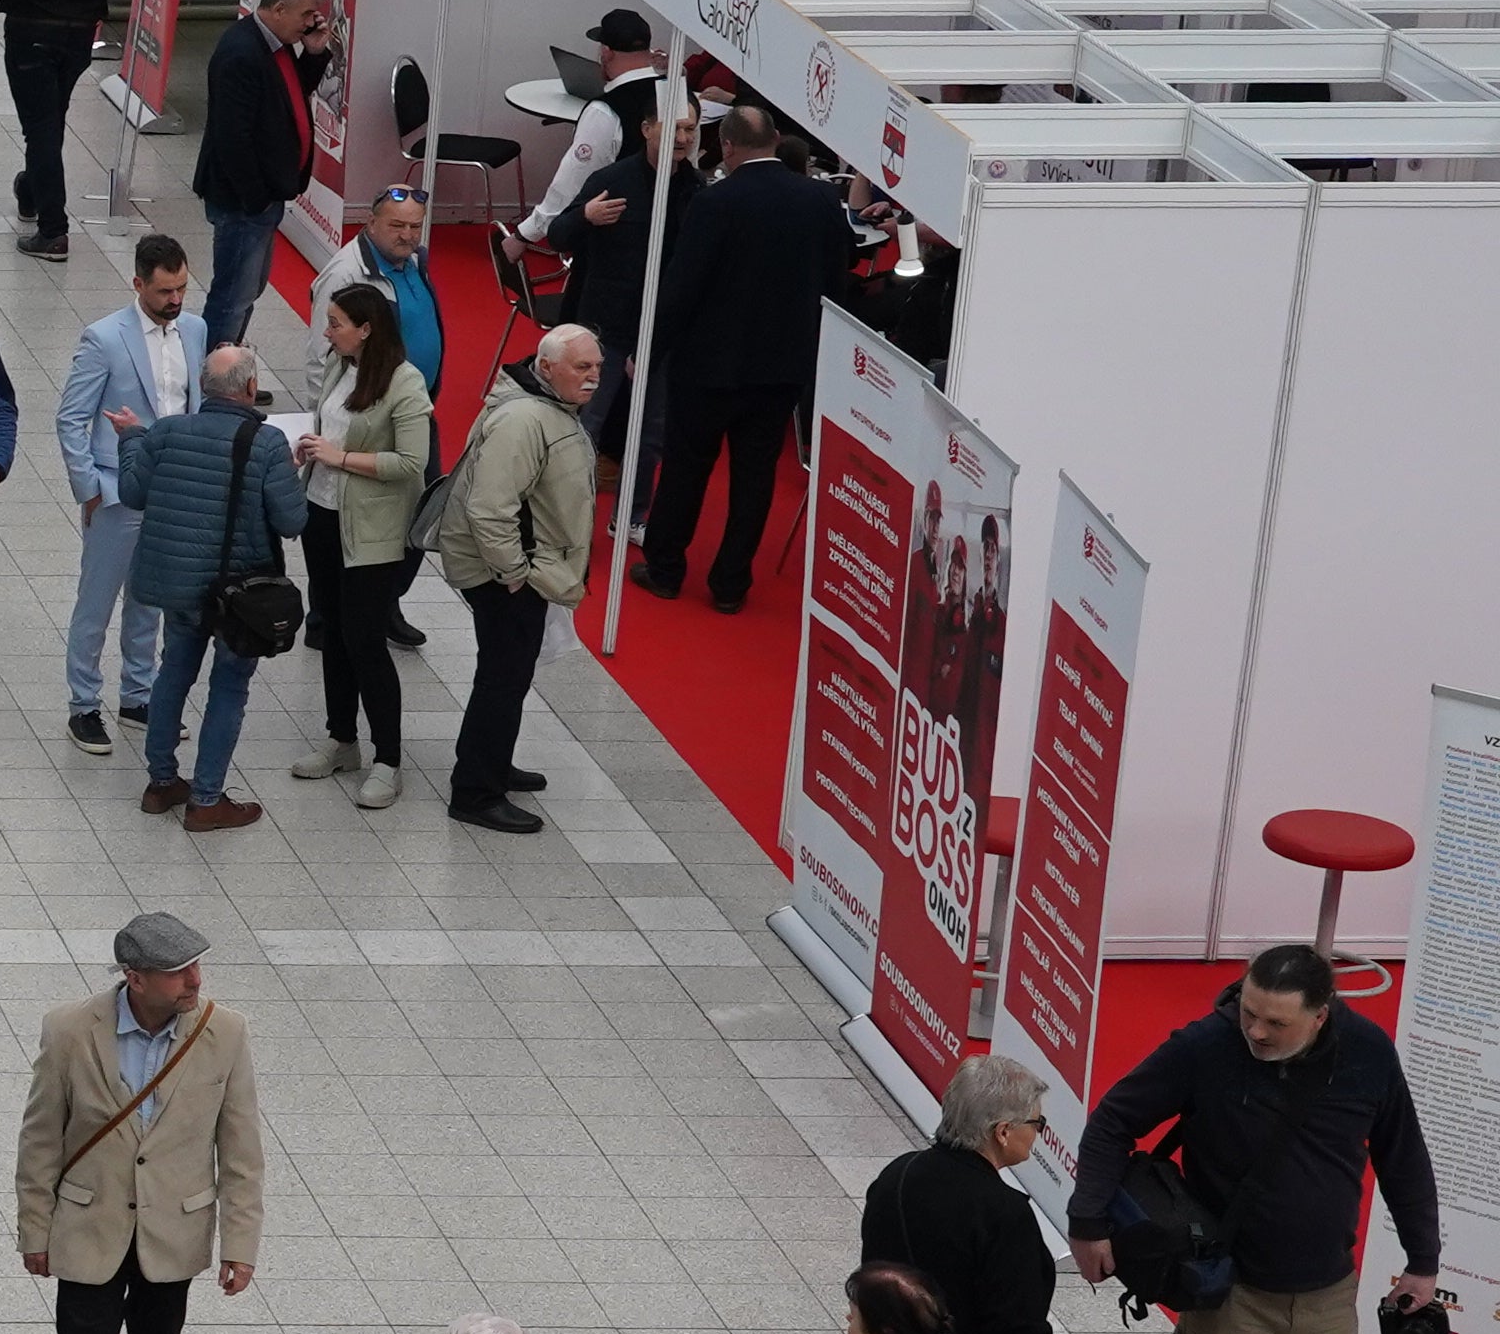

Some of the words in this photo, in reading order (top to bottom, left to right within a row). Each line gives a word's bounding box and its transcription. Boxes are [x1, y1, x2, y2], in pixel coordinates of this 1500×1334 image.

[901, 698, 960, 816] BUĎ
[799, 844, 879, 938] SOUBOSONOHY.C
[895, 774, 972, 909] BOSS
[929, 884, 967, 951] ONOH
